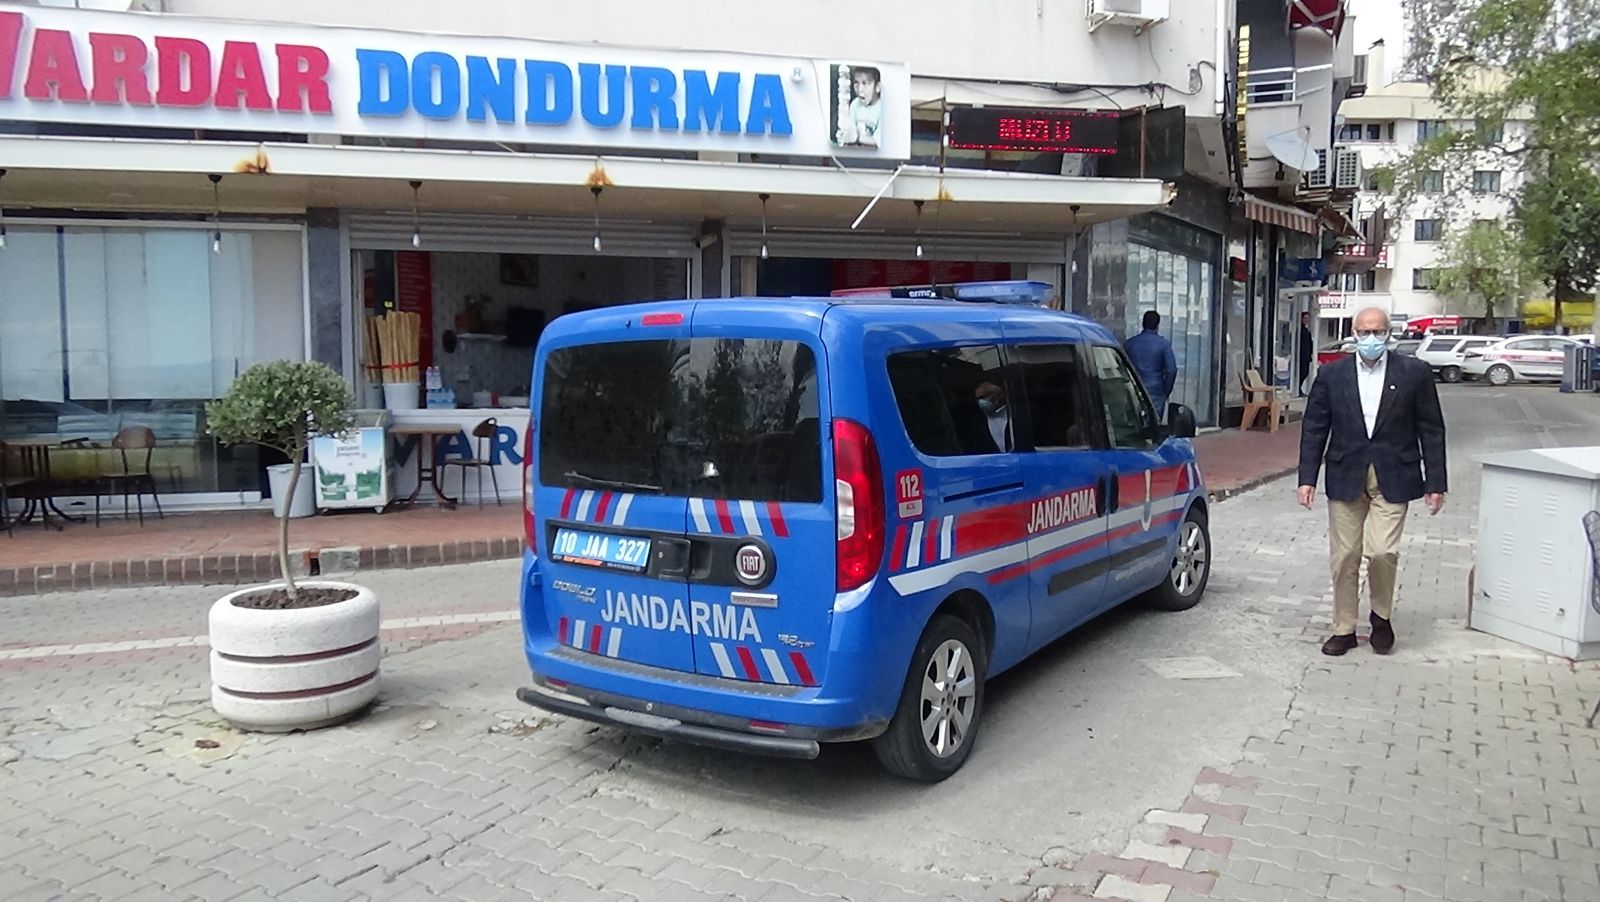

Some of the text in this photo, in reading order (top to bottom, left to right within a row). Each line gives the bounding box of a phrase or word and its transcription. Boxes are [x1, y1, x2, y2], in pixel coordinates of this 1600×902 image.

[356, 48, 792, 136] DONDURMA
[900, 474, 920, 498] 112
[1027, 488, 1097, 534] JANDARMA
[560, 532, 578, 554] 10
[581, 534, 609, 559] JAA
[615, 538, 646, 563] 327
[742, 555, 760, 572] FIAT
[601, 589, 763, 643] JANDARMA
